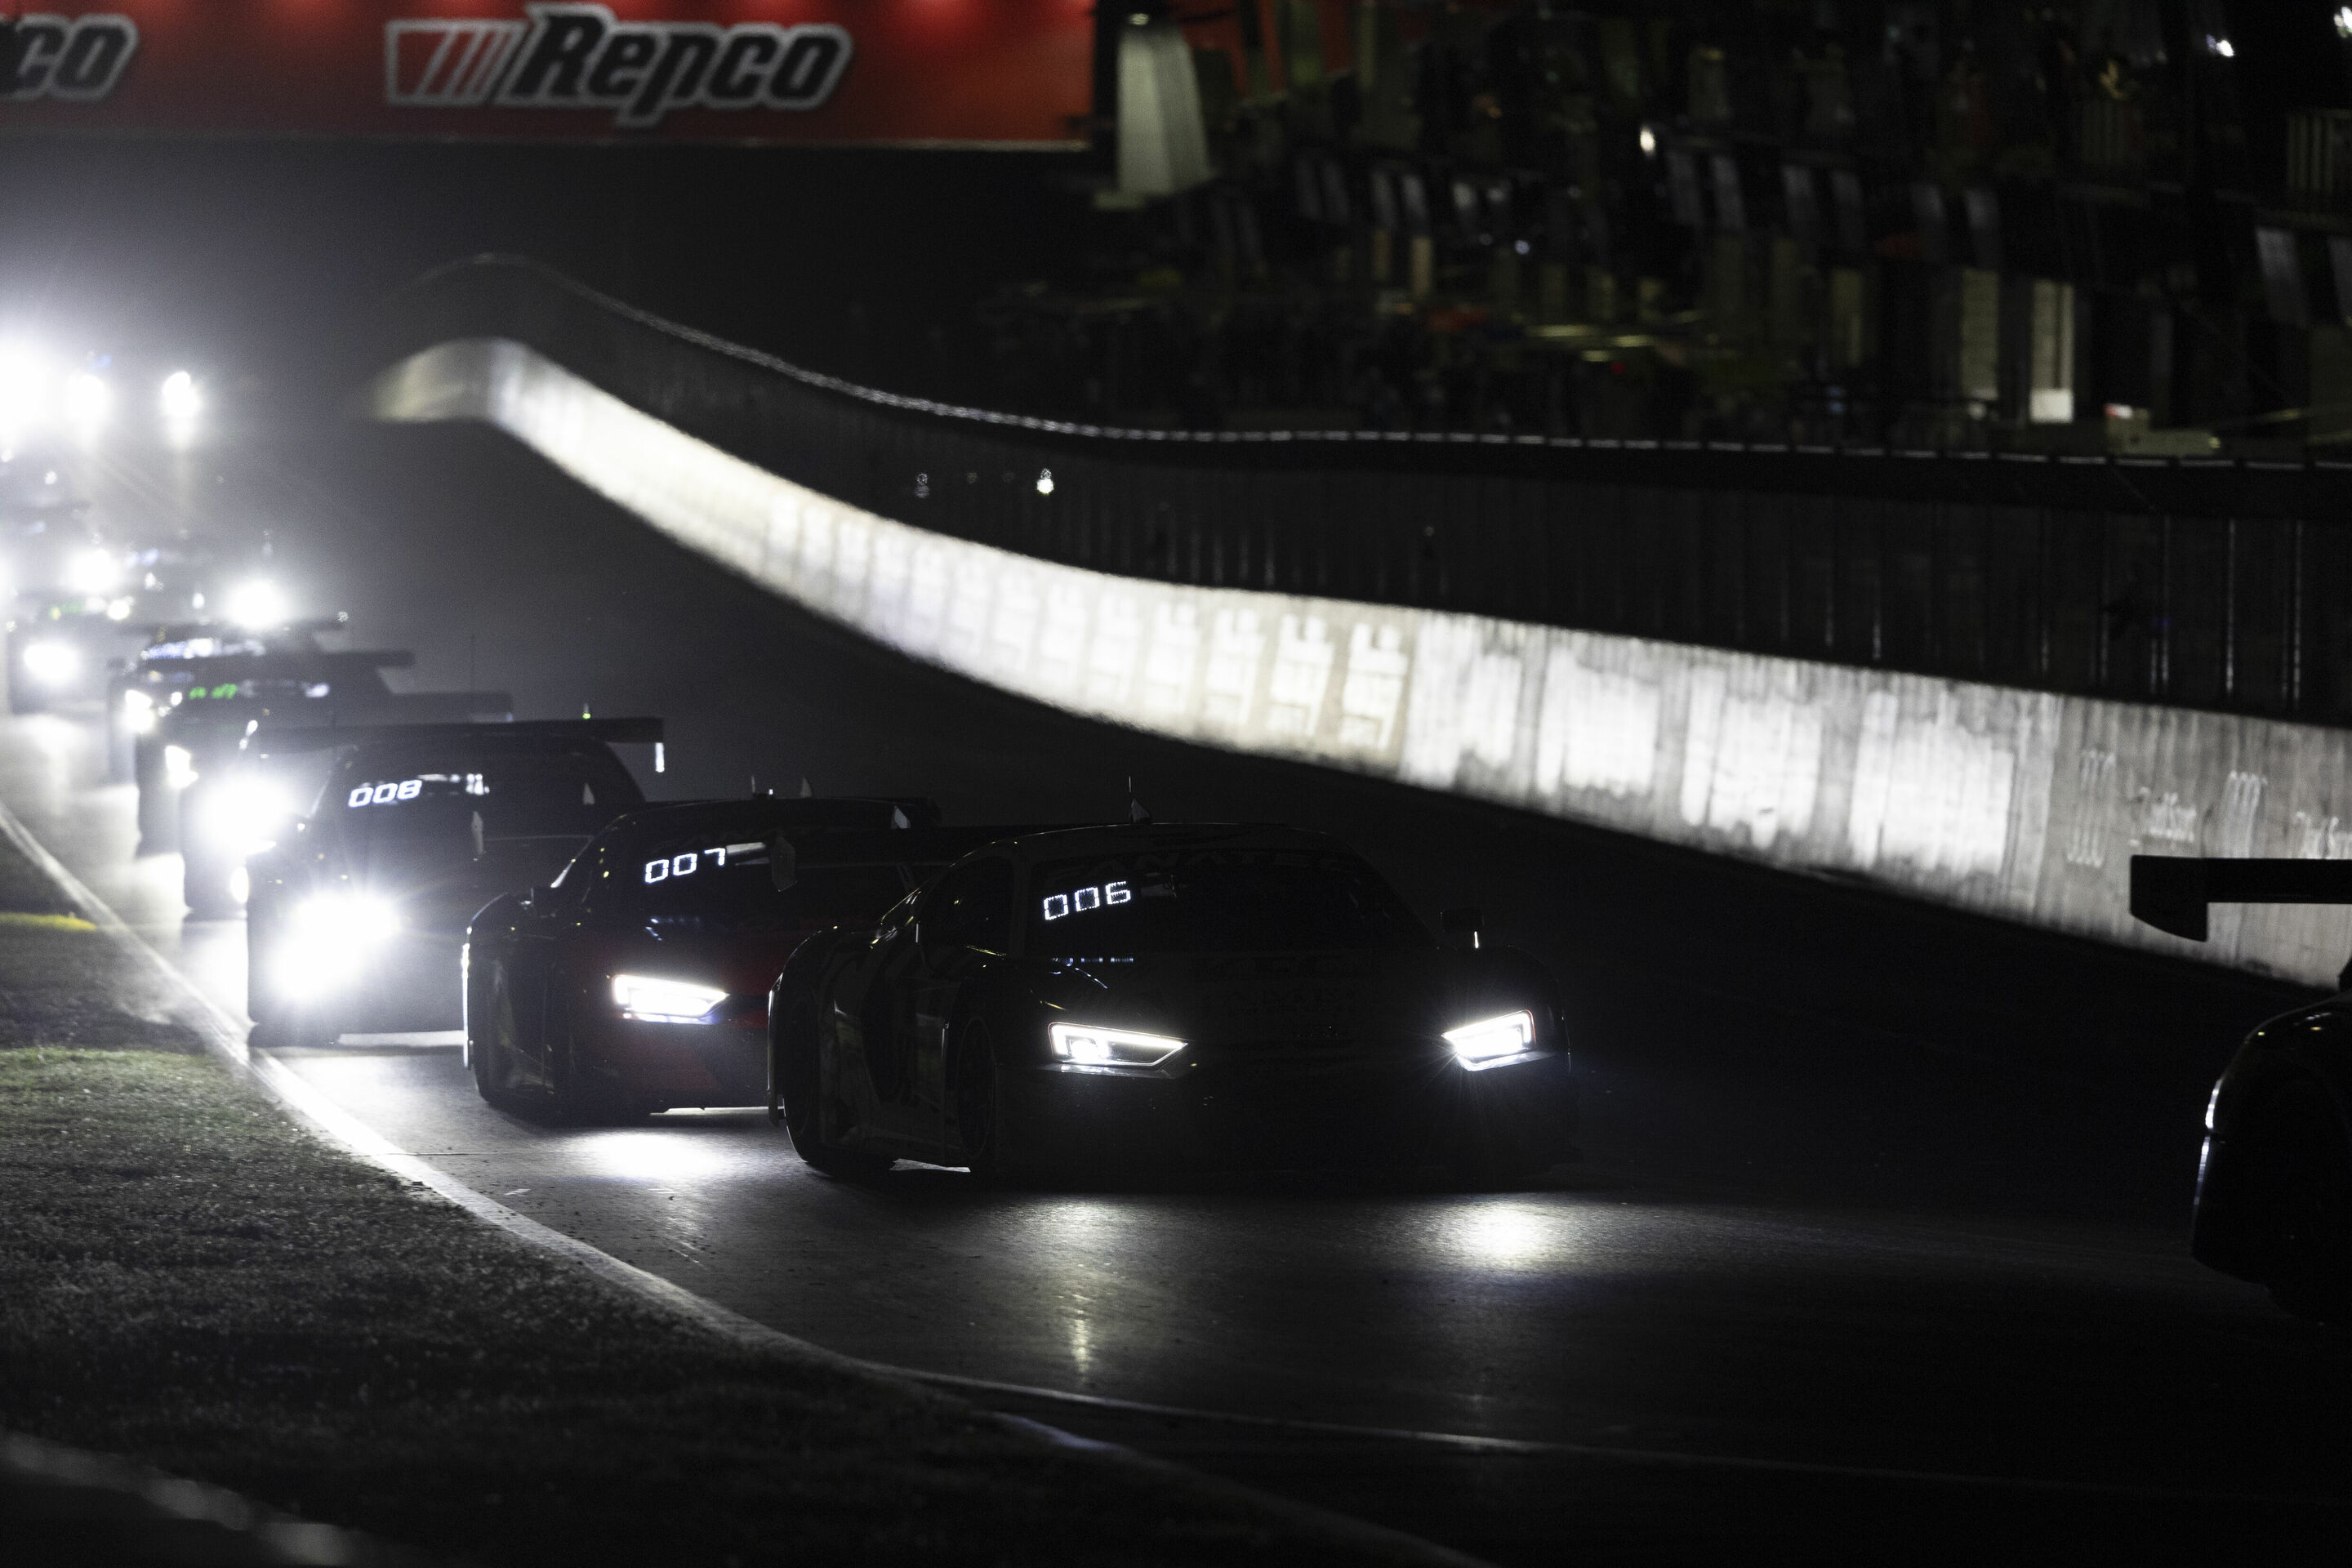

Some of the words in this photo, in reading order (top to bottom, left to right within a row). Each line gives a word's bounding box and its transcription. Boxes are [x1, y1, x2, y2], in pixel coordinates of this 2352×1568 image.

[0, 15, 136, 99] co
[500, 5, 851, 124] Repco
[348, 779, 422, 808] 008
[644, 847, 726, 884] 007
[1043, 880, 1131, 921] 006
